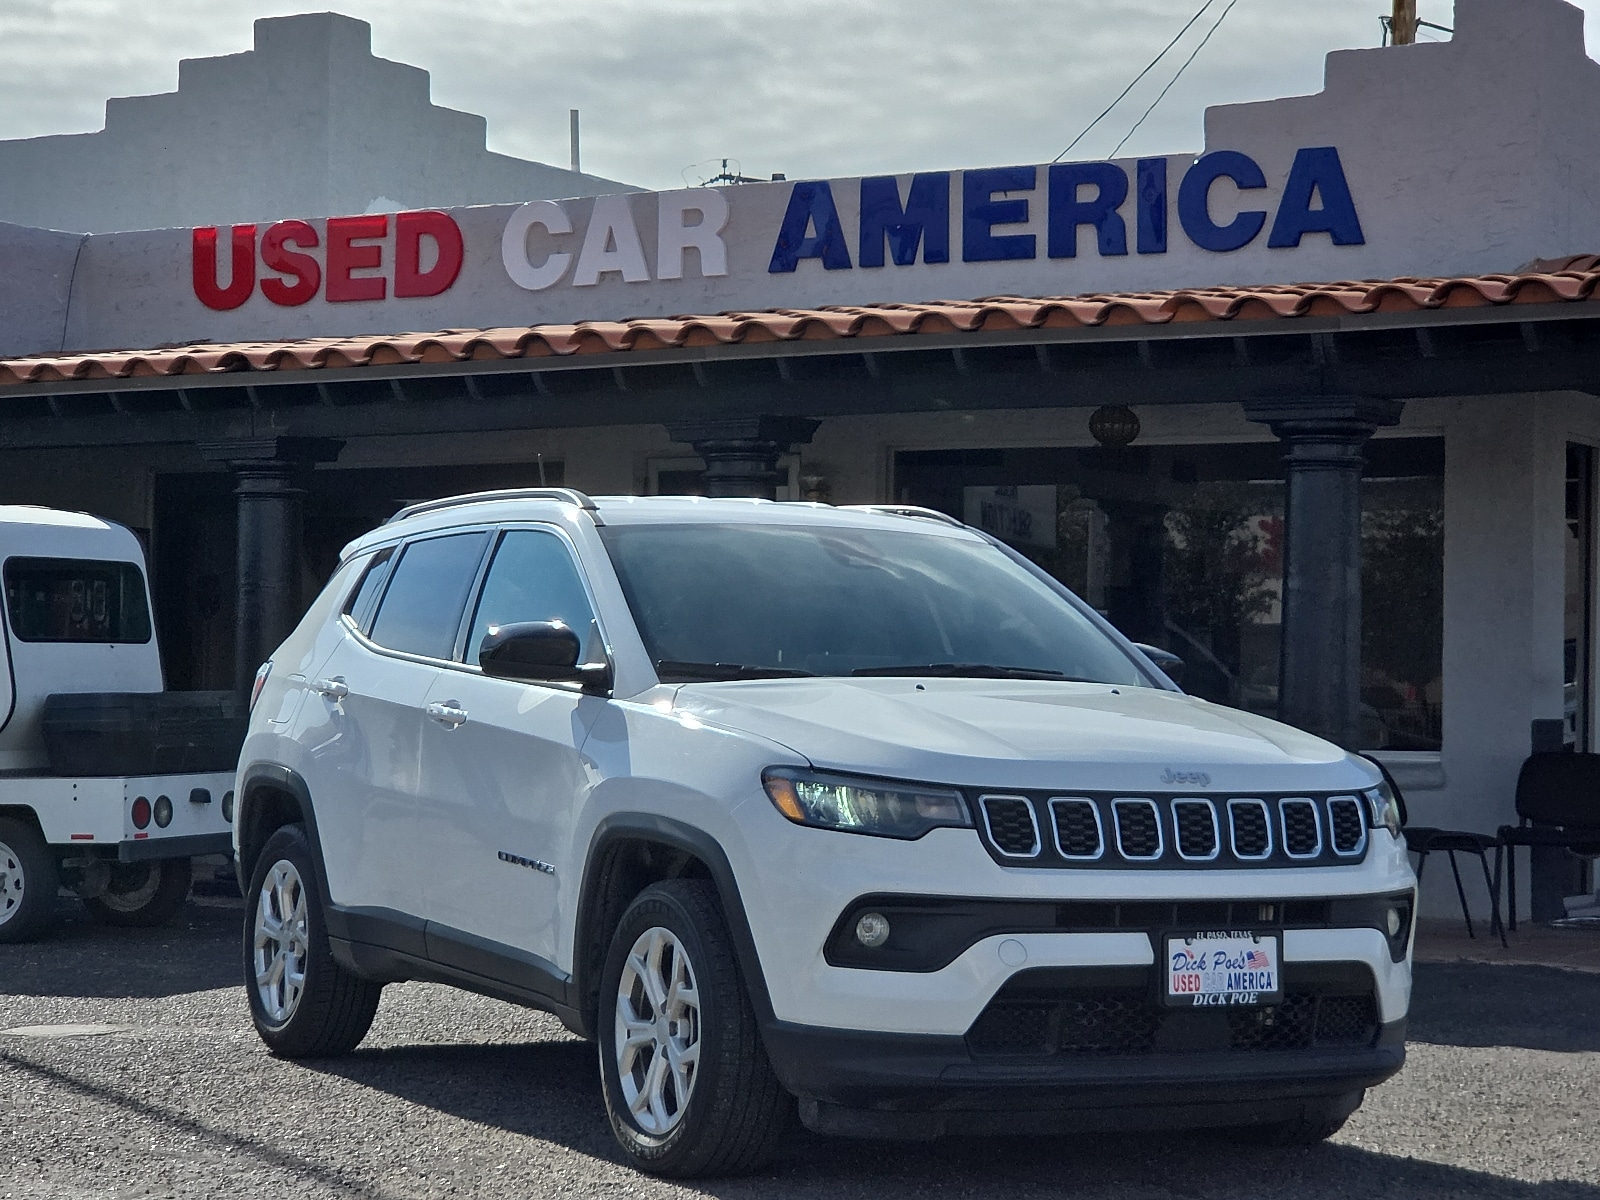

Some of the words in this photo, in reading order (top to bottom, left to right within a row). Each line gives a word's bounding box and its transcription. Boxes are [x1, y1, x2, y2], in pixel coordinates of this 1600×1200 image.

[192, 210, 464, 311] USED
[501, 188, 730, 291] CAR
[768, 146, 1366, 274] AMERICA
[1160, 767, 1211, 787] Jeep
[1230, 930, 1252, 939] TEXAS
[1172, 952, 1206, 972] Dick
[1213, 950, 1247, 971] Poe's
[1173, 974, 1200, 992] USED
[1227, 972, 1272, 991] AMERICA
[1193, 993, 1228, 1006] DICK
[1230, 992, 1259, 1004] POE
